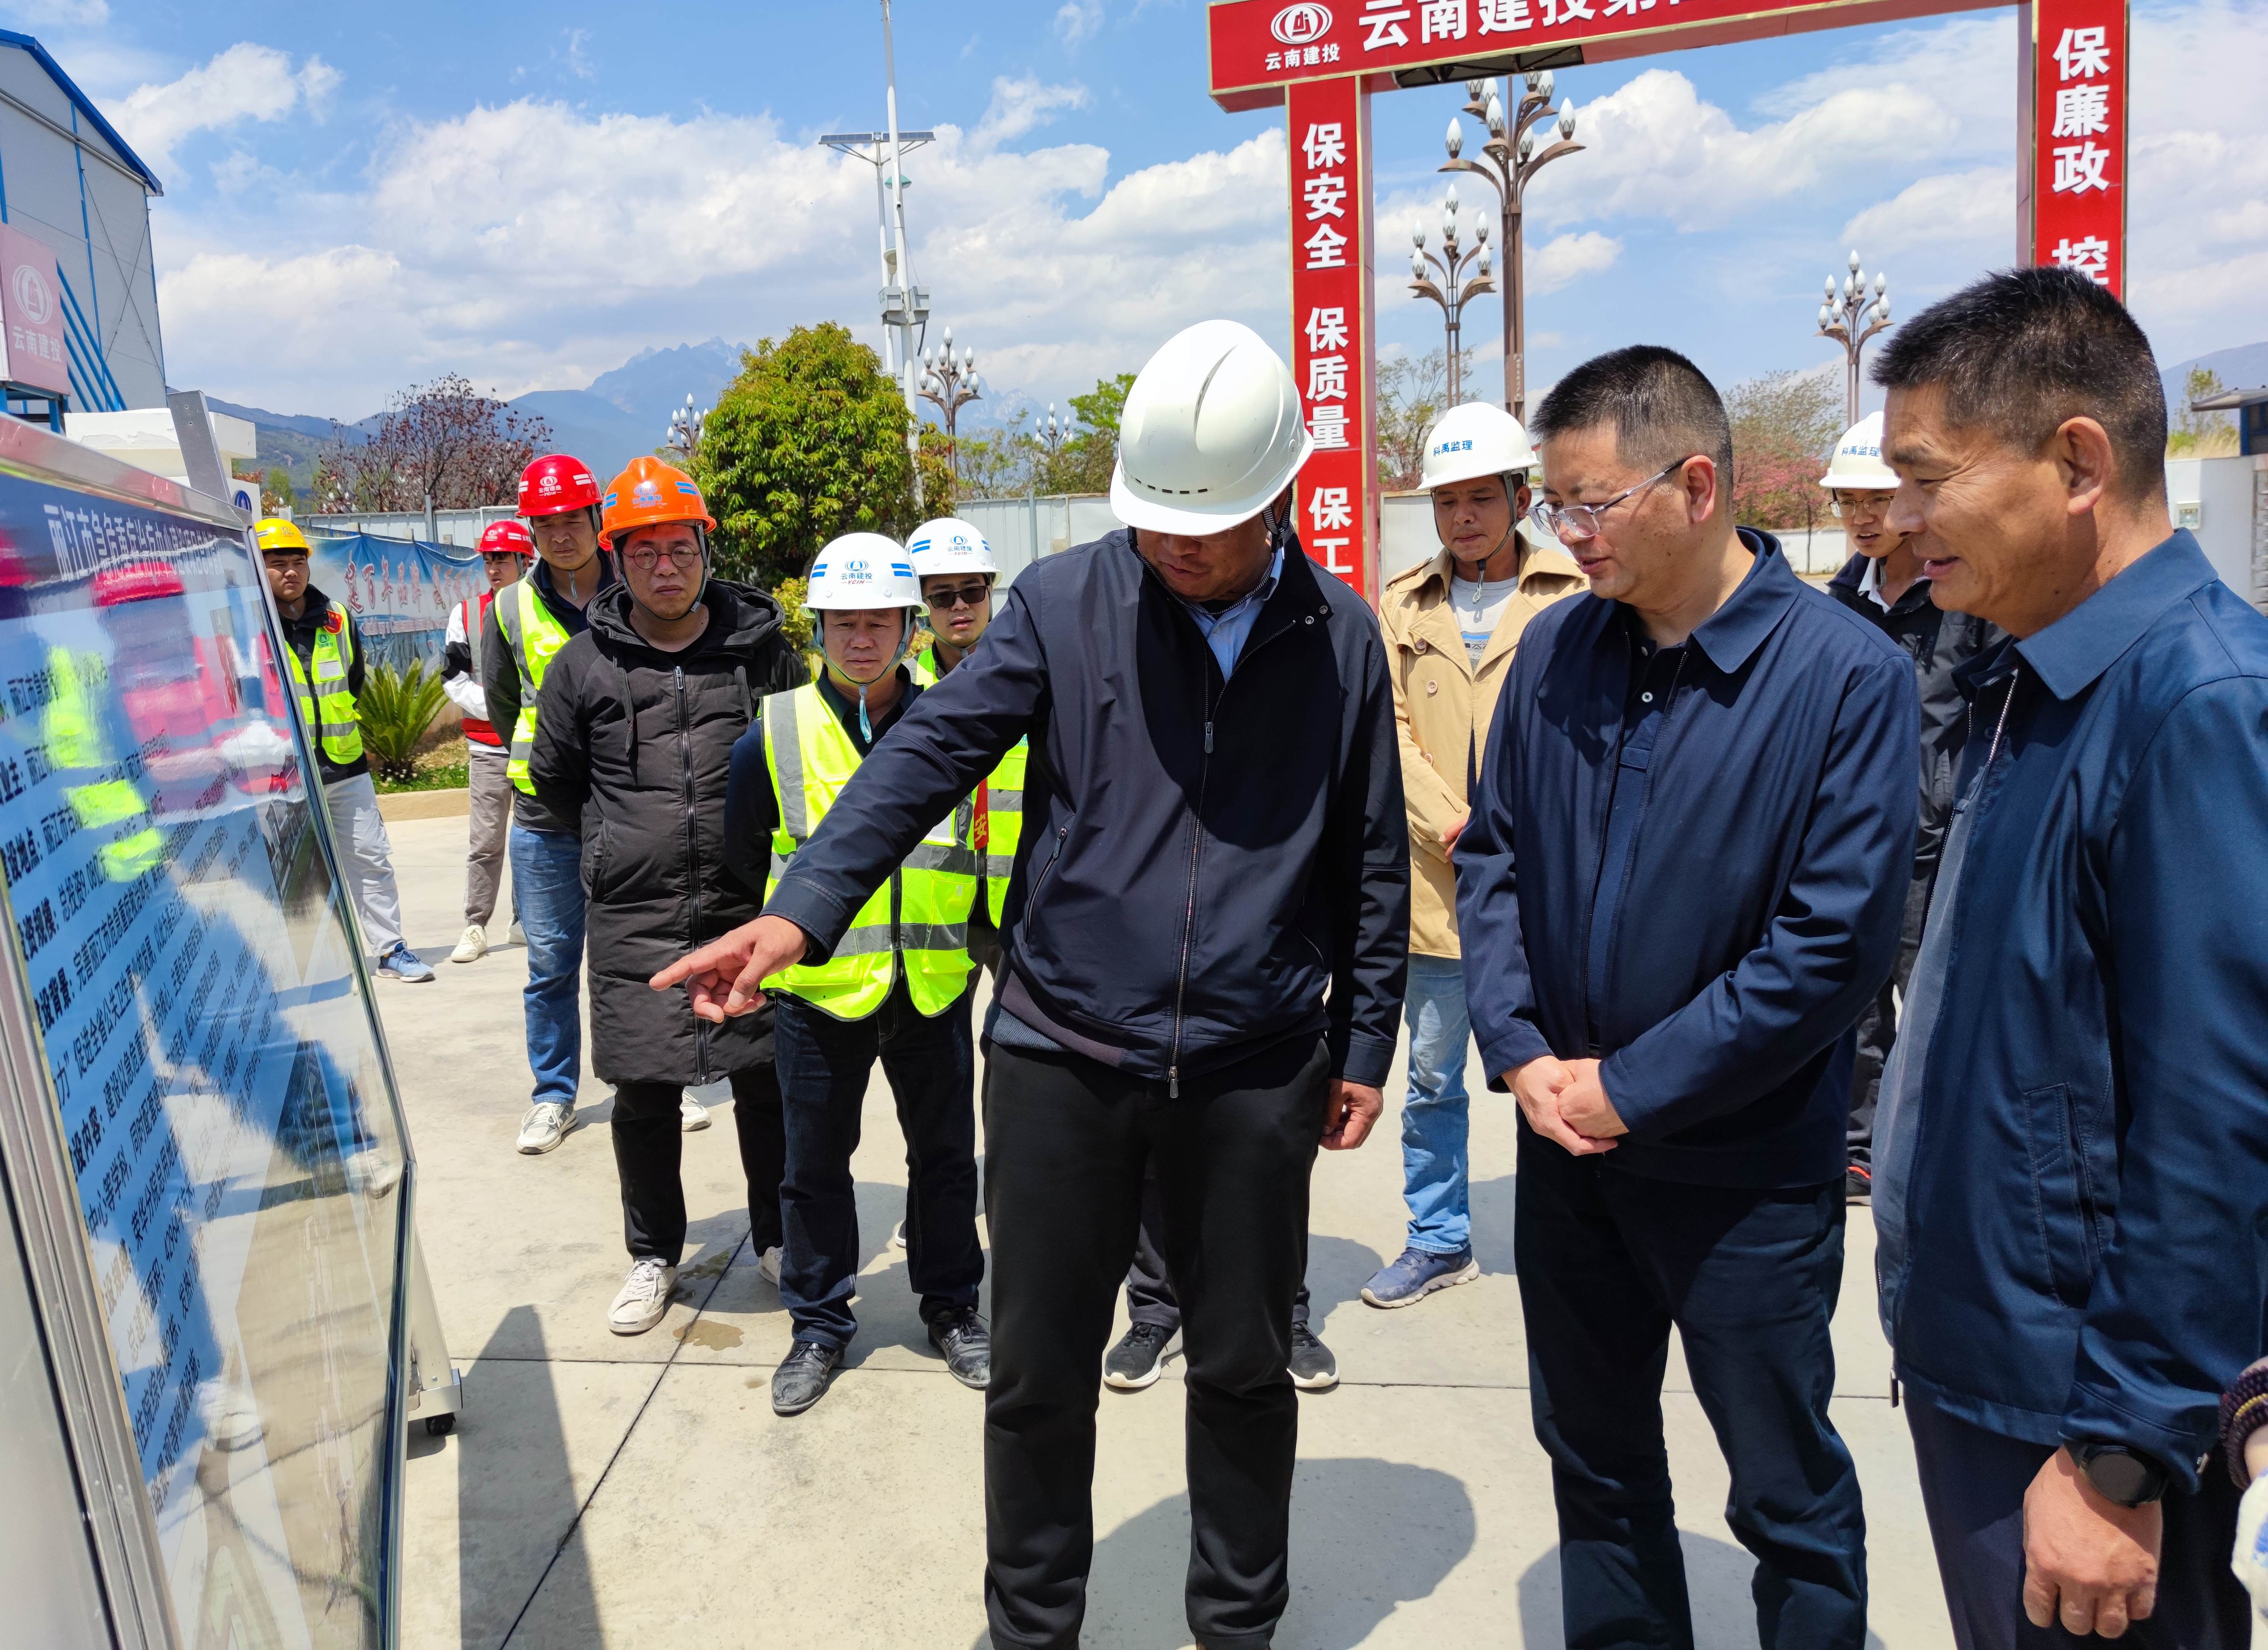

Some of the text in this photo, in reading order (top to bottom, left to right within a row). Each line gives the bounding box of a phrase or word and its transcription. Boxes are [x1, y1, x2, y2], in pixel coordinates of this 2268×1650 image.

[1359, 0, 1681, 52] 云南建投
[1264, 43, 1341, 71] 云南建投
[2051, 25, 2110, 195] 保廉政
[12, 325, 62, 363] 云南建投
[1302, 123, 1354, 591] 保安全 保质量 保工
[1433, 440, 1473, 458] 科禹监理
